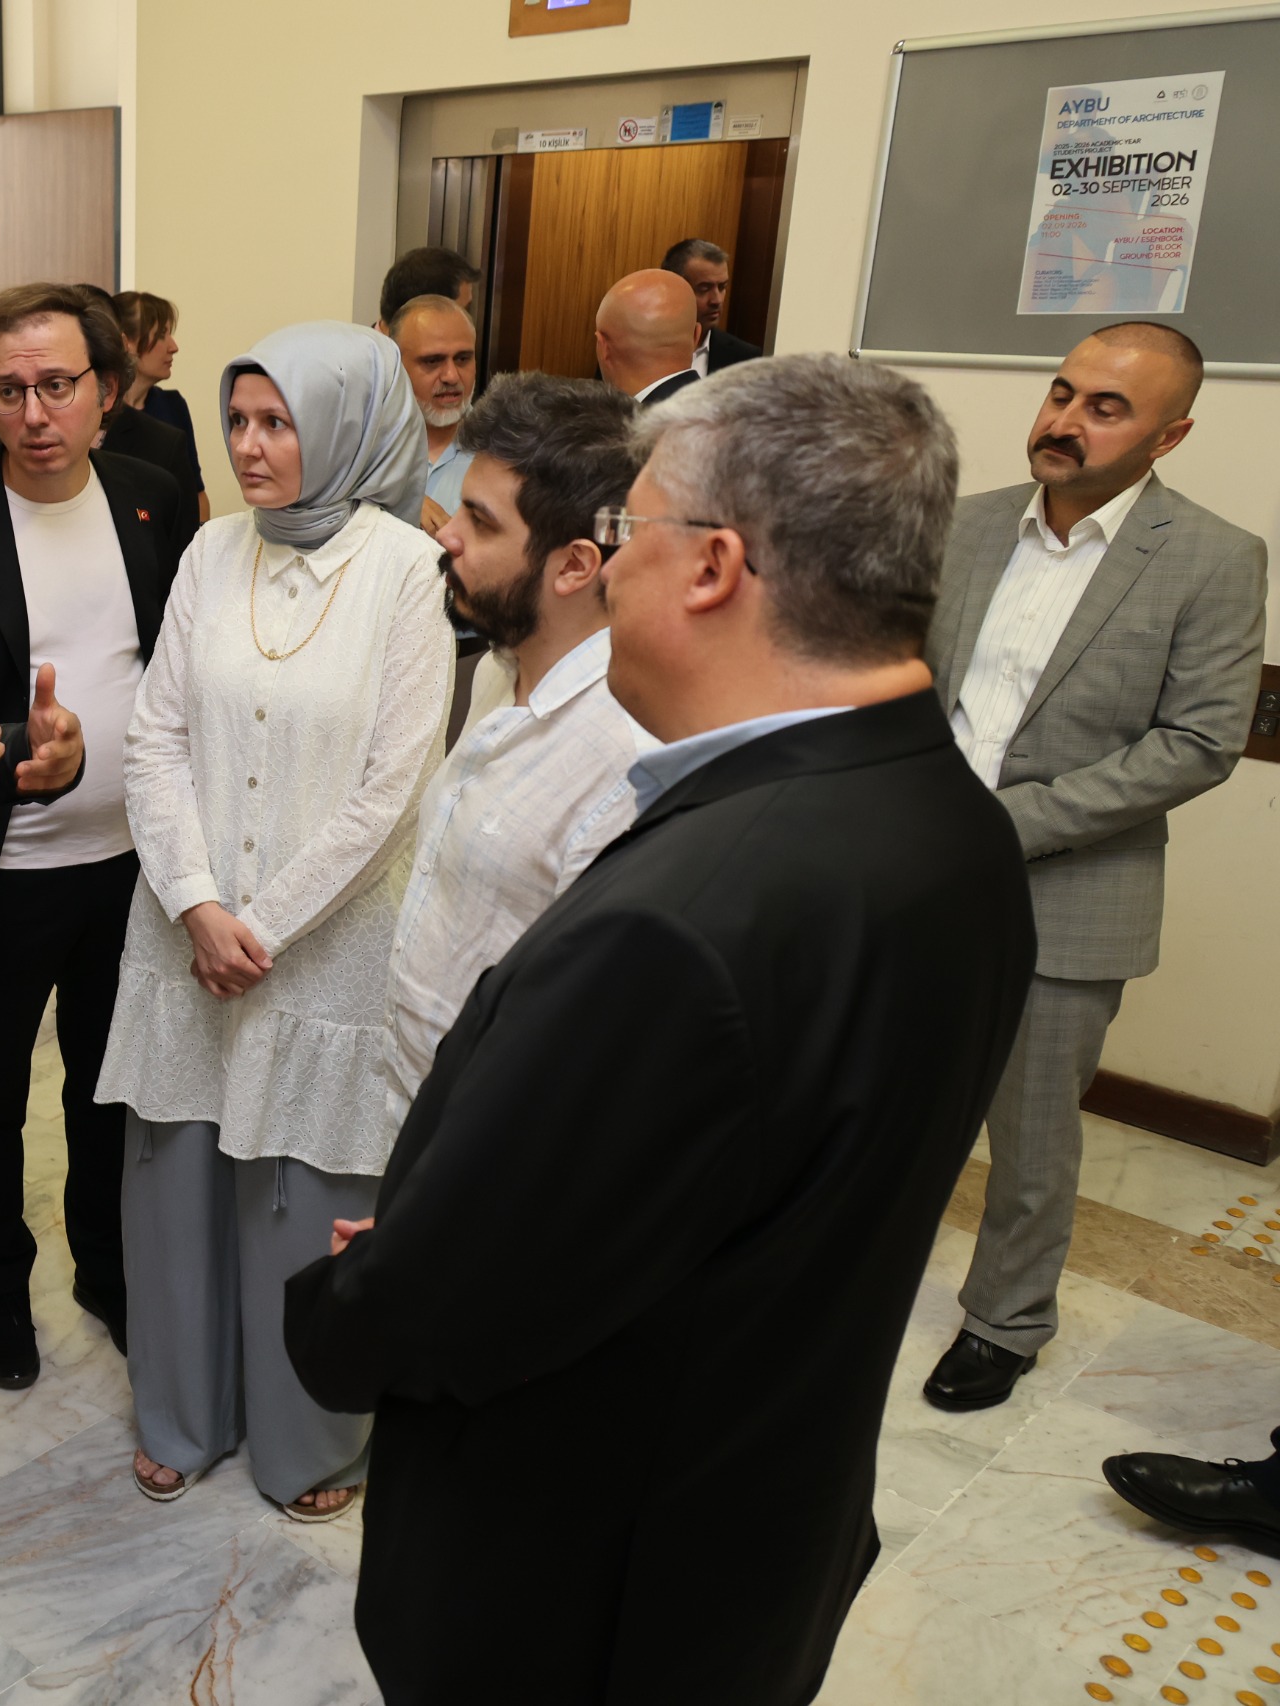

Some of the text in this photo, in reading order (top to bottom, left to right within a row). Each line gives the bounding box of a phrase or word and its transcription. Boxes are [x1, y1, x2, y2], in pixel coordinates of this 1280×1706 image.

[1059, 97, 1110, 115] AYBU
[1057, 109, 1205, 129] DEPARTMENT OF ARCHITECTURE
[540, 140, 547, 148] 10
[1053, 146, 1112, 156] STUDENTS PROJECT
[1050, 150, 1197, 179] EXHIBITION
[1052, 176, 1192, 196] 02-30 SEPTEMBER
[1151, 193, 1189, 207] 2026
[1142, 226, 1184, 235] LOCATION:
[1156, 243, 1182, 251] BLOCK
[1120, 251, 1181, 260] GROUND FLOOR
